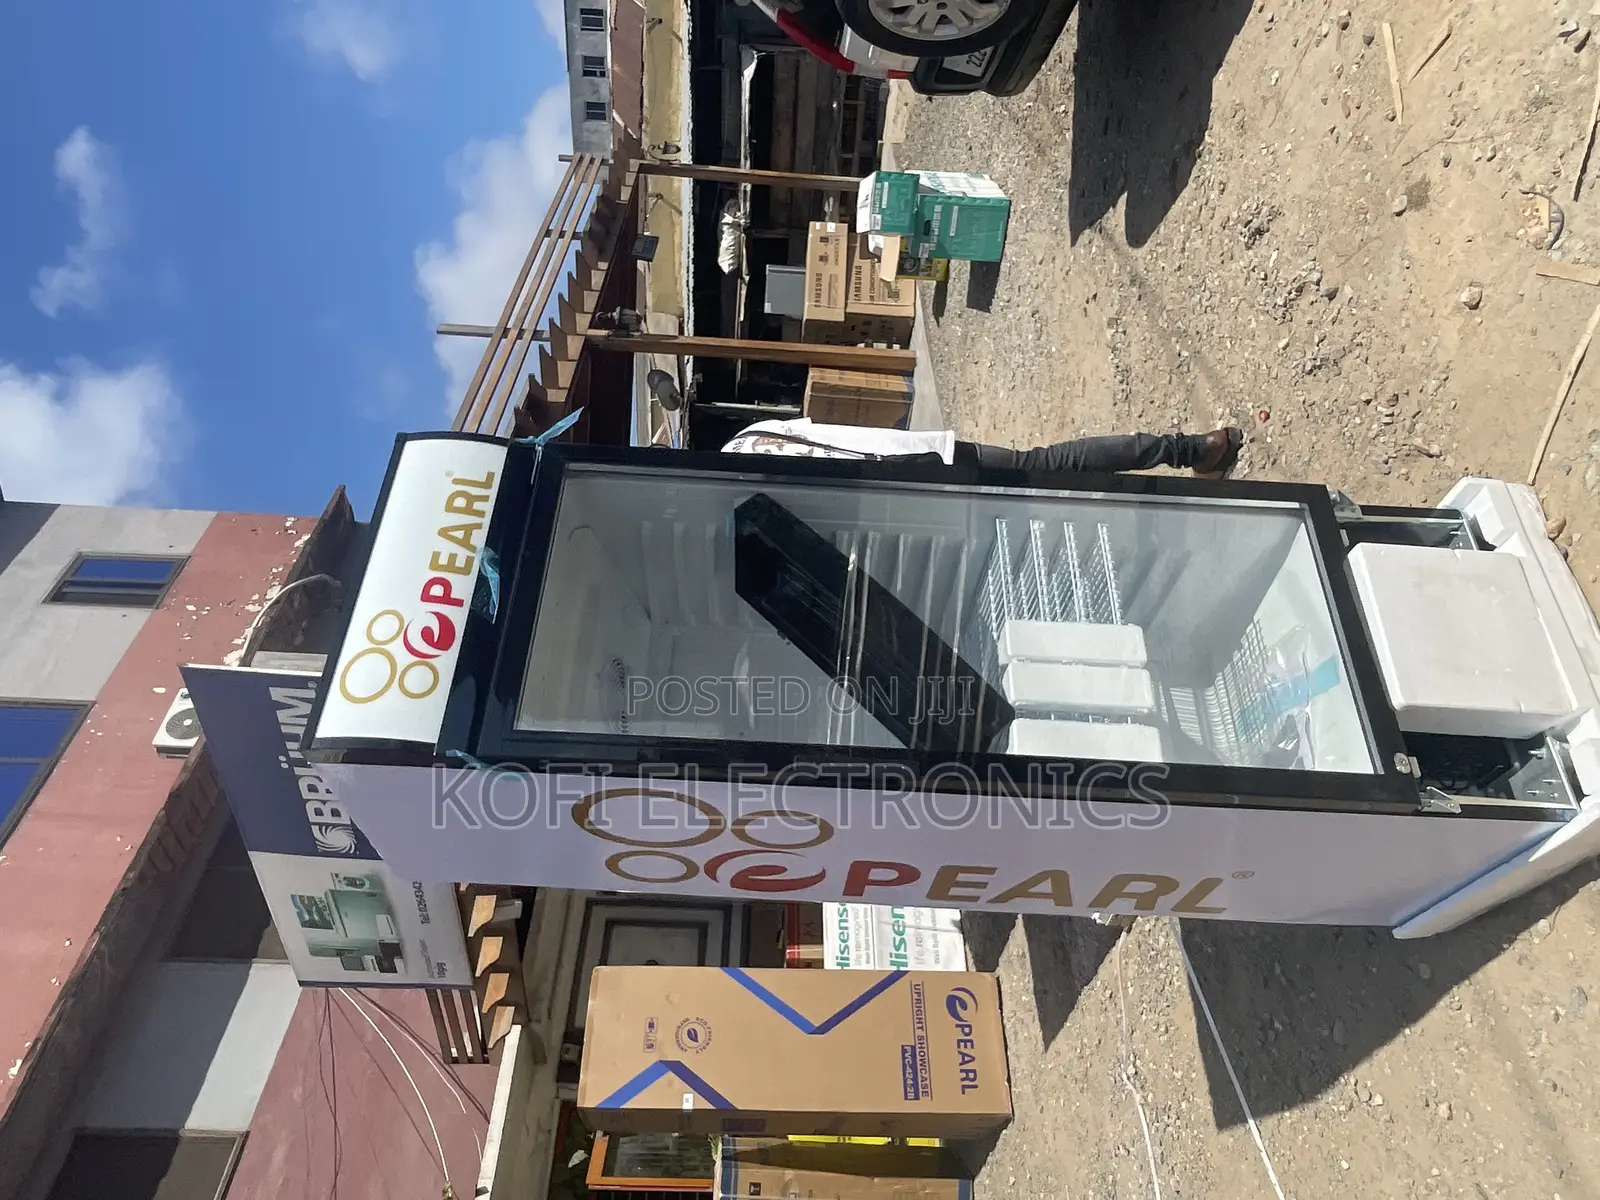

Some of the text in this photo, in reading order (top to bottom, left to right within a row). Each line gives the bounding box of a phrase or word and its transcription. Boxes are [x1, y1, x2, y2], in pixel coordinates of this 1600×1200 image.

[814, 272, 822, 308] SAMSUNG
[854, 265, 862, 301] SAMSUNG
[914, 984, 929, 1096] UPRIGHT SHOWCASE
[904, 1046, 915, 1099] PVC-424-2B
